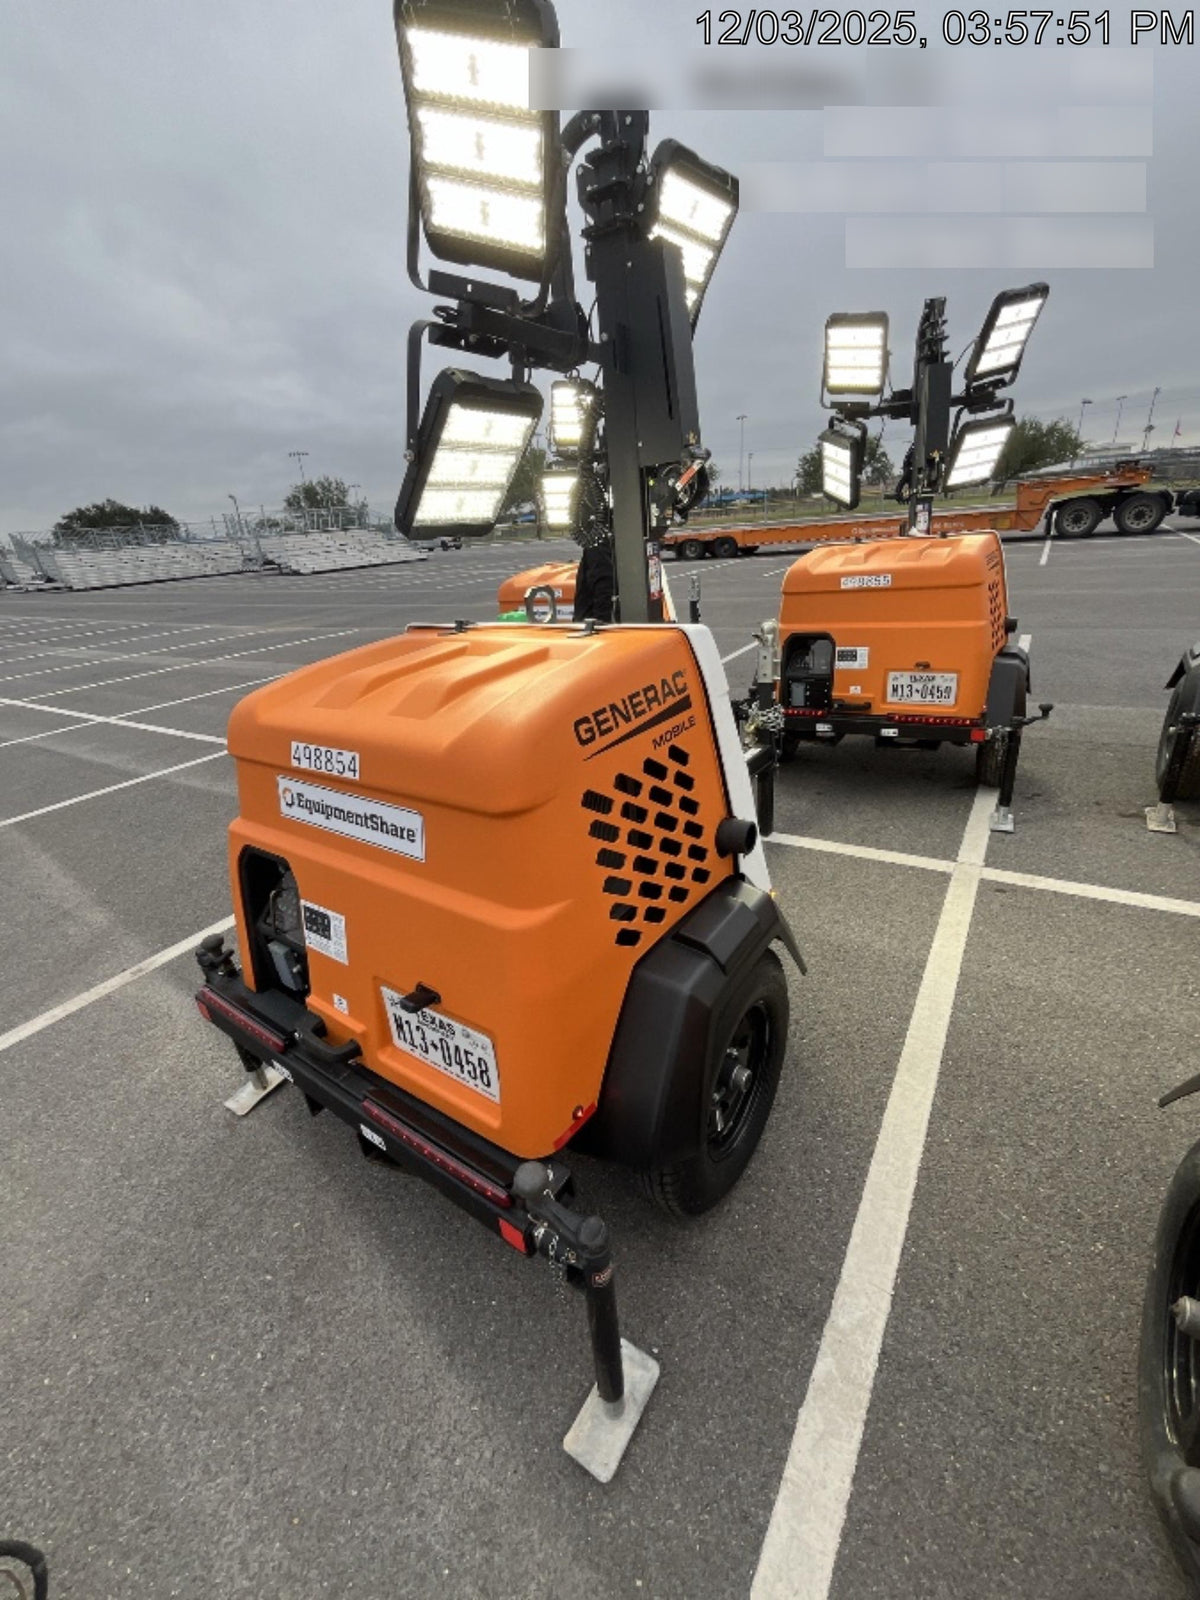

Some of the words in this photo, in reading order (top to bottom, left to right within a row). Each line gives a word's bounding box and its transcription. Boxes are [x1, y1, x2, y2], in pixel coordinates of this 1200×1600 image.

[573, 669, 688, 747] GENERAC
[652, 715, 696, 750] MOBILE
[292, 744, 358, 778] 498854
[296, 792, 416, 843] EquipmentShare
